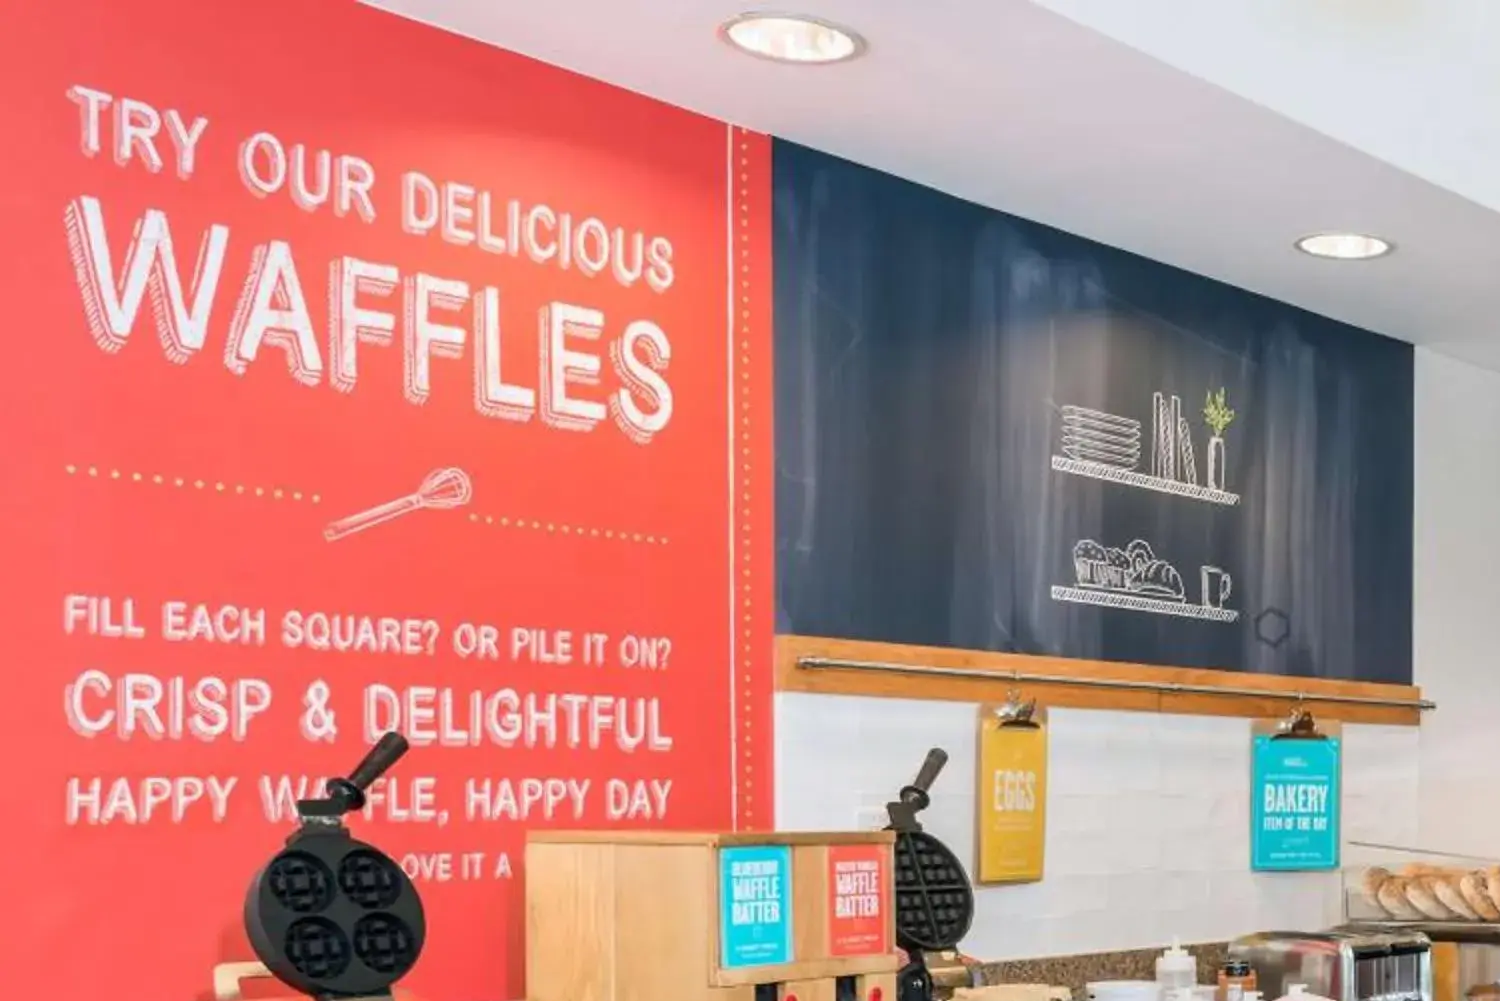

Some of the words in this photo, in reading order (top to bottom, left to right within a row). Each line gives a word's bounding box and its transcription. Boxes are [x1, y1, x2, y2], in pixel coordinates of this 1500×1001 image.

[66, 84, 209, 181] TRY
[238, 132, 376, 223] OUR
[402, 170, 675, 294] DELICIOUS
[63, 194, 673, 445] WAFFLES
[64, 595, 145, 638] FILL
[161, 601, 265, 646] EACH
[281, 609, 440, 656] SQUARE?
[453, 622, 499, 659] OR
[511, 627, 573, 665] PILE
[583, 633, 608, 667] IT
[620, 636, 672, 670] ON?
[64, 669, 272, 742] CRISP
[299, 678, 338, 744] &
[363, 682, 673, 753] DELIGHTFUL
[65, 776, 239, 825] HAPPY
[258, 774, 449, 828] WFLE,
[465, 778, 591, 822] HAPPY
[606, 779, 673, 820] DAY
[994, 770, 1036, 812] EGGS
[1264, 783, 1329, 813] BAKERY
[399, 852, 453, 882] OVE
[461, 852, 485, 879] IT
[494, 852, 513, 879] A
[835, 871, 879, 894] WAFFLE
[732, 876, 781, 901] WAFFLE
[835, 894, 879, 918] BATTER
[731, 900, 780, 926] BATTER
